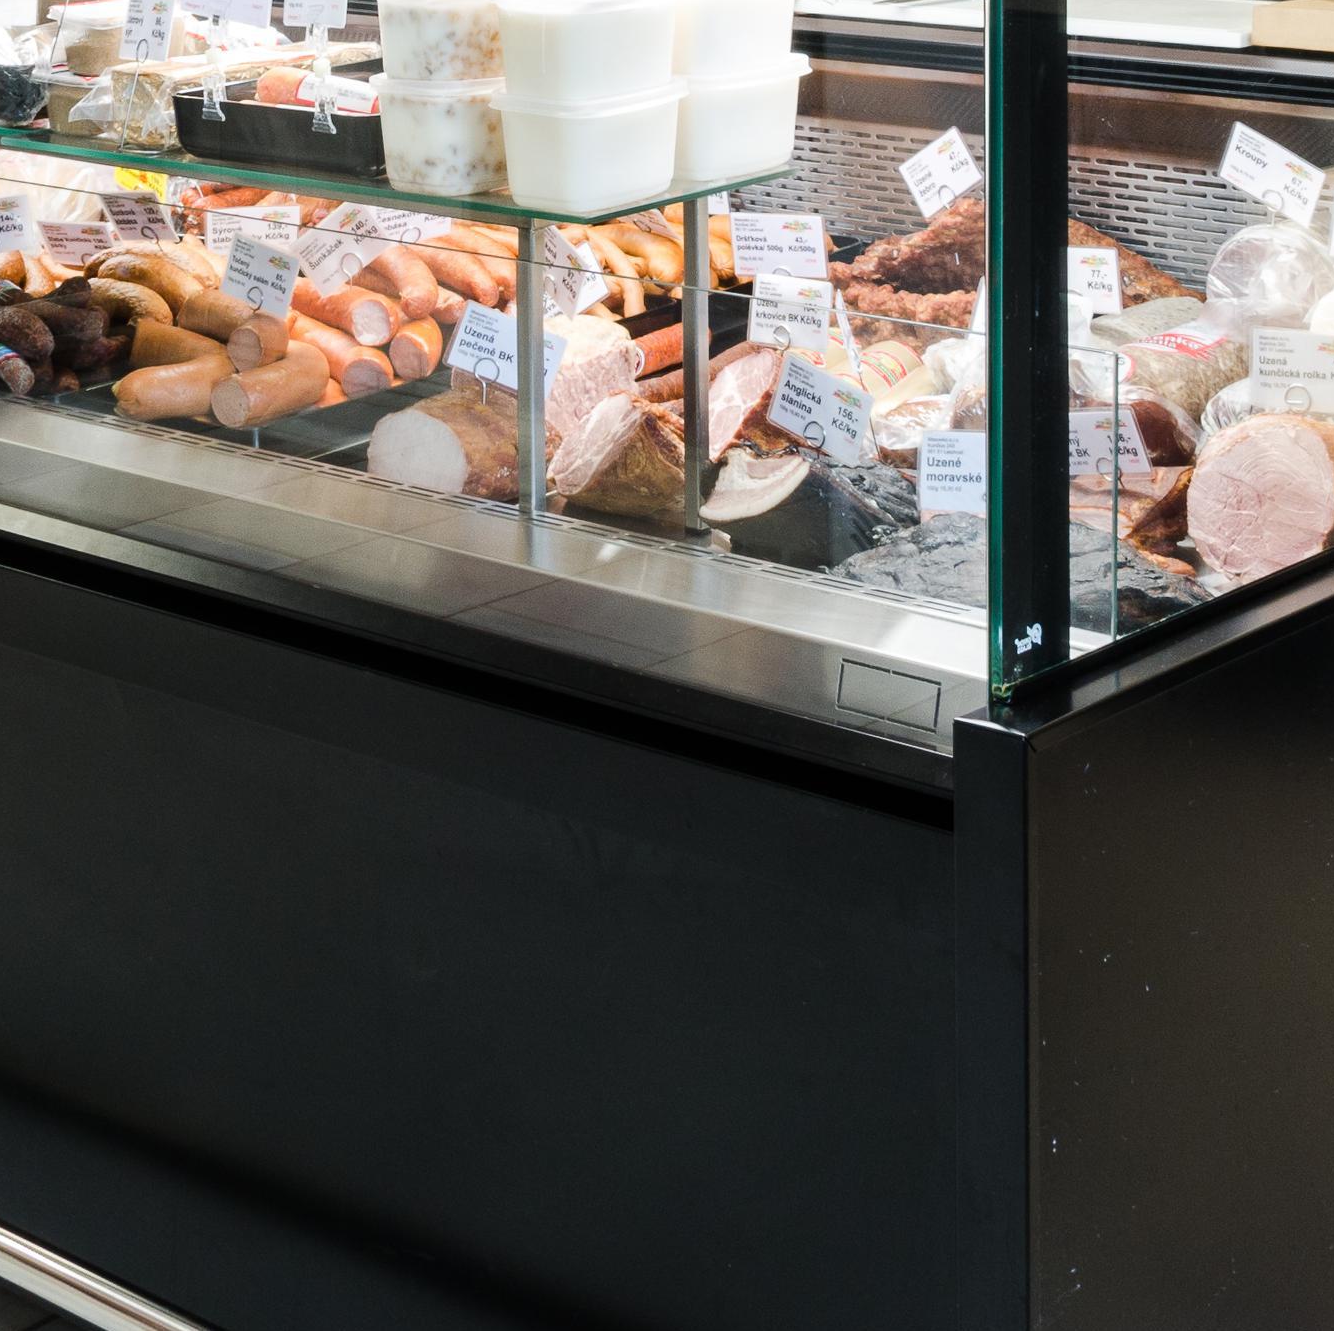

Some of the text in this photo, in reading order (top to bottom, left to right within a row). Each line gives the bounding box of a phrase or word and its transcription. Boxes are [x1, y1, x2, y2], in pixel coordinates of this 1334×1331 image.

[1235, 143, 1268, 169] Kroupy
[1283, 183, 1309, 206] Kč/kg
[308, 238, 345, 270] Šunkáček
[767, 245, 783, 253] 500g
[1090, 270, 1108, 278] 77,-
[1087, 280, 1113, 291] Kč/kg
[756, 310, 822, 328] krkovice BK Kč/kg
[463, 324, 495, 343] Uzená
[498, 350, 515, 364] BK
[1258, 356, 1287, 366] Uzená
[1258, 367, 1300, 379] kunčická
[1303, 371, 1326, 380] rolka
[784, 380, 822, 405] Anglická
[781, 392, 858, 423] slanina 156,-
[831, 417, 858, 439] Kč/kg
[1075, 448, 1090, 457] BK
[926, 455, 962, 468] Uzené
[926, 471, 982, 484] moravské
